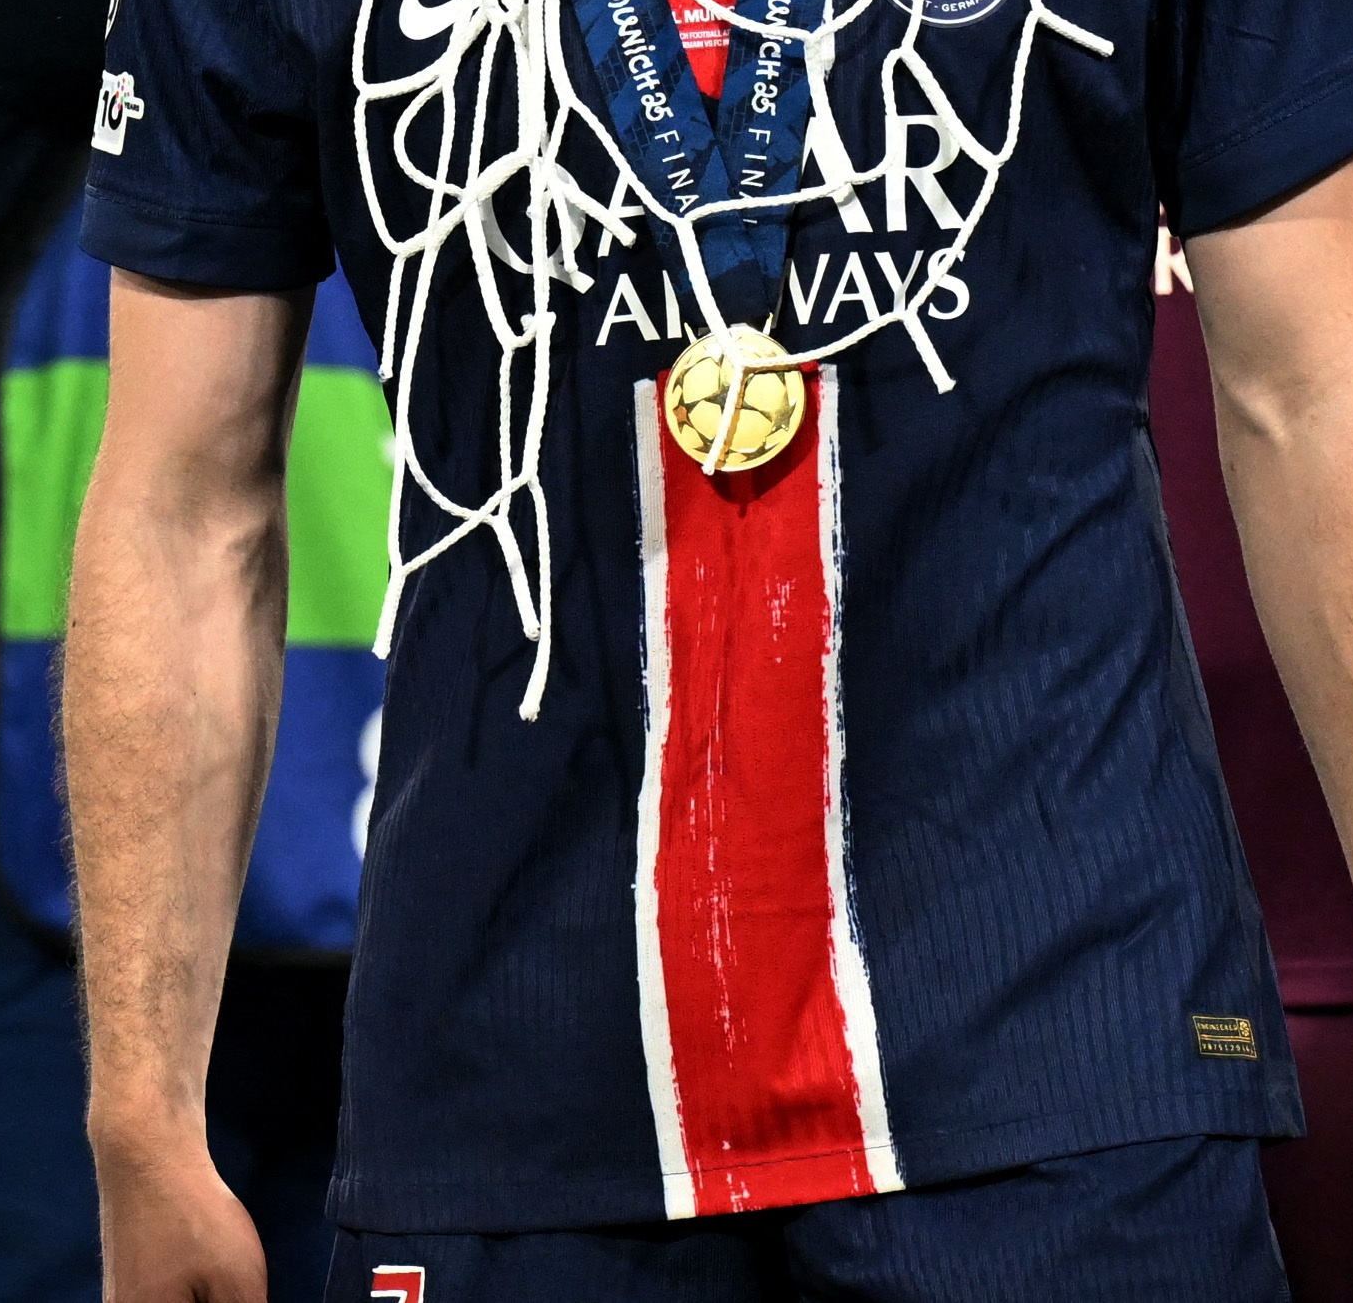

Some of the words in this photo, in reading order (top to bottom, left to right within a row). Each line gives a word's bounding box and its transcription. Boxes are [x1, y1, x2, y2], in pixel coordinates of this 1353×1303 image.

[124, 102, 140, 112] YEARS
[654, 129, 700, 213] FINA
[595, 248, 970, 347] AIWAYS
